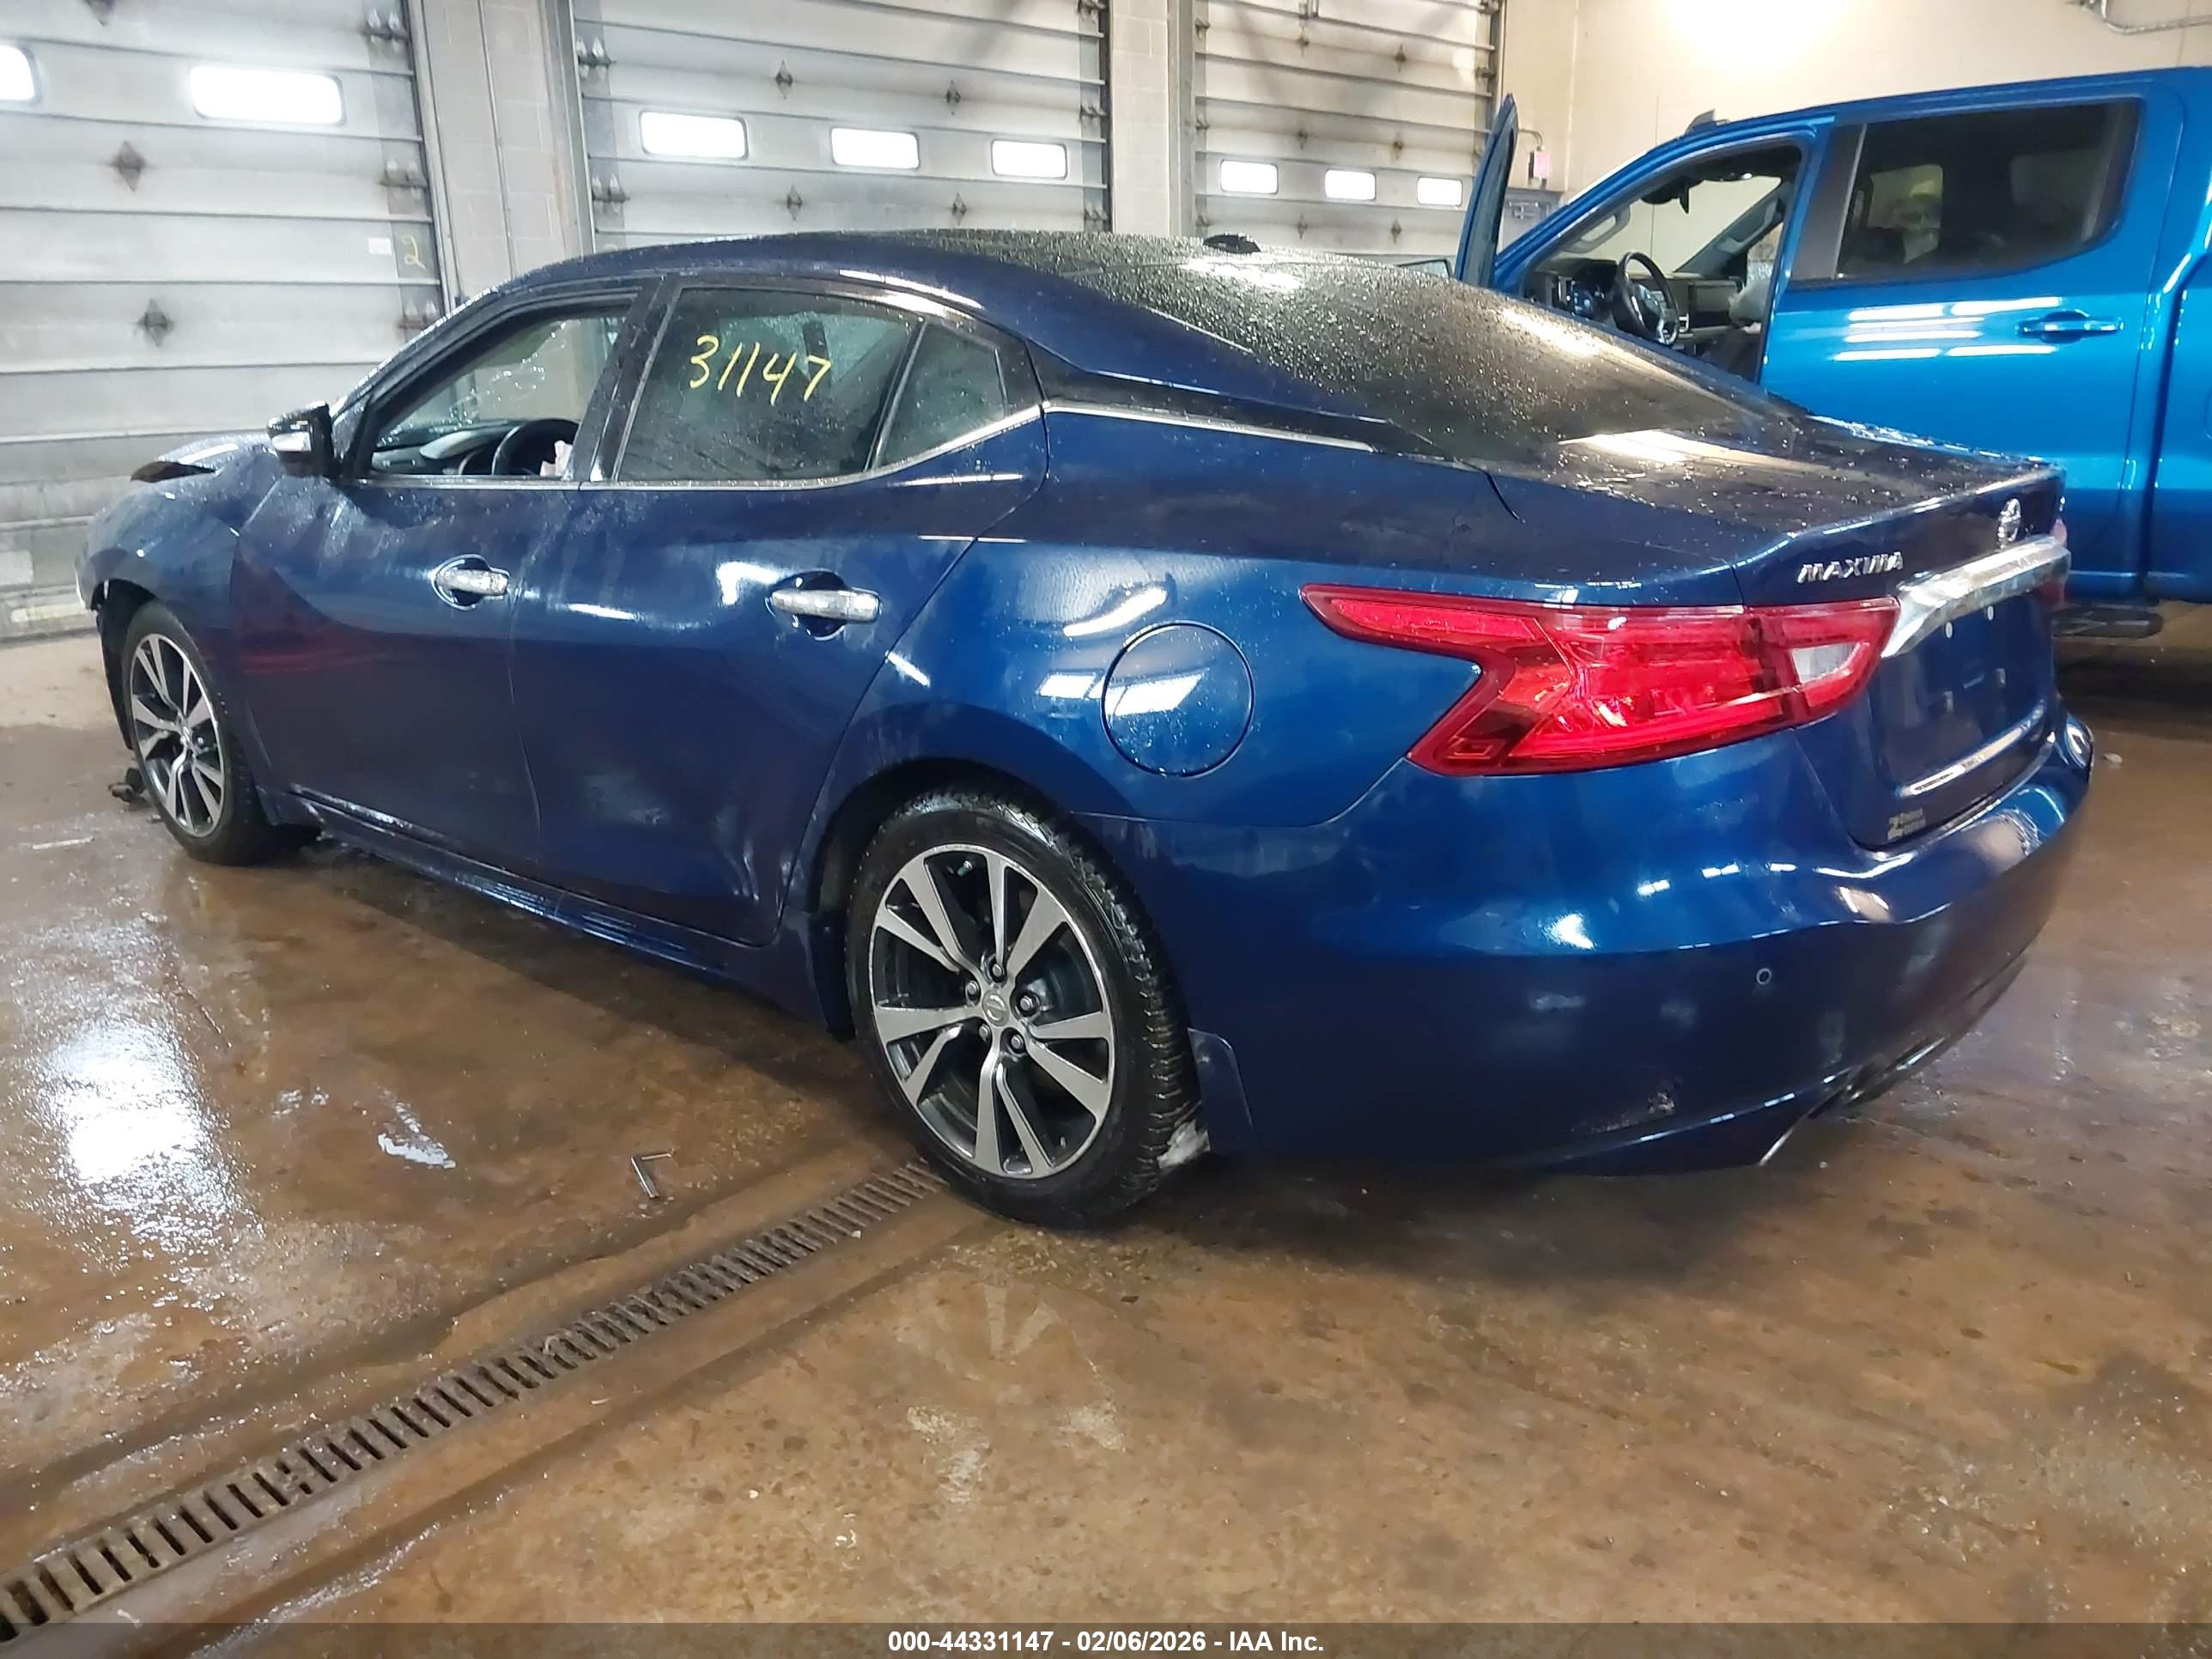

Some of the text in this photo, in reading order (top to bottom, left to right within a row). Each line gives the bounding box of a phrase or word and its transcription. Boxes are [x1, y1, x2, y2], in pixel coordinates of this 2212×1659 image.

[401, 234, 427, 270] 2
[689, 333, 833, 406] 31147
[1796, 550, 1905, 584] MAXIMA
